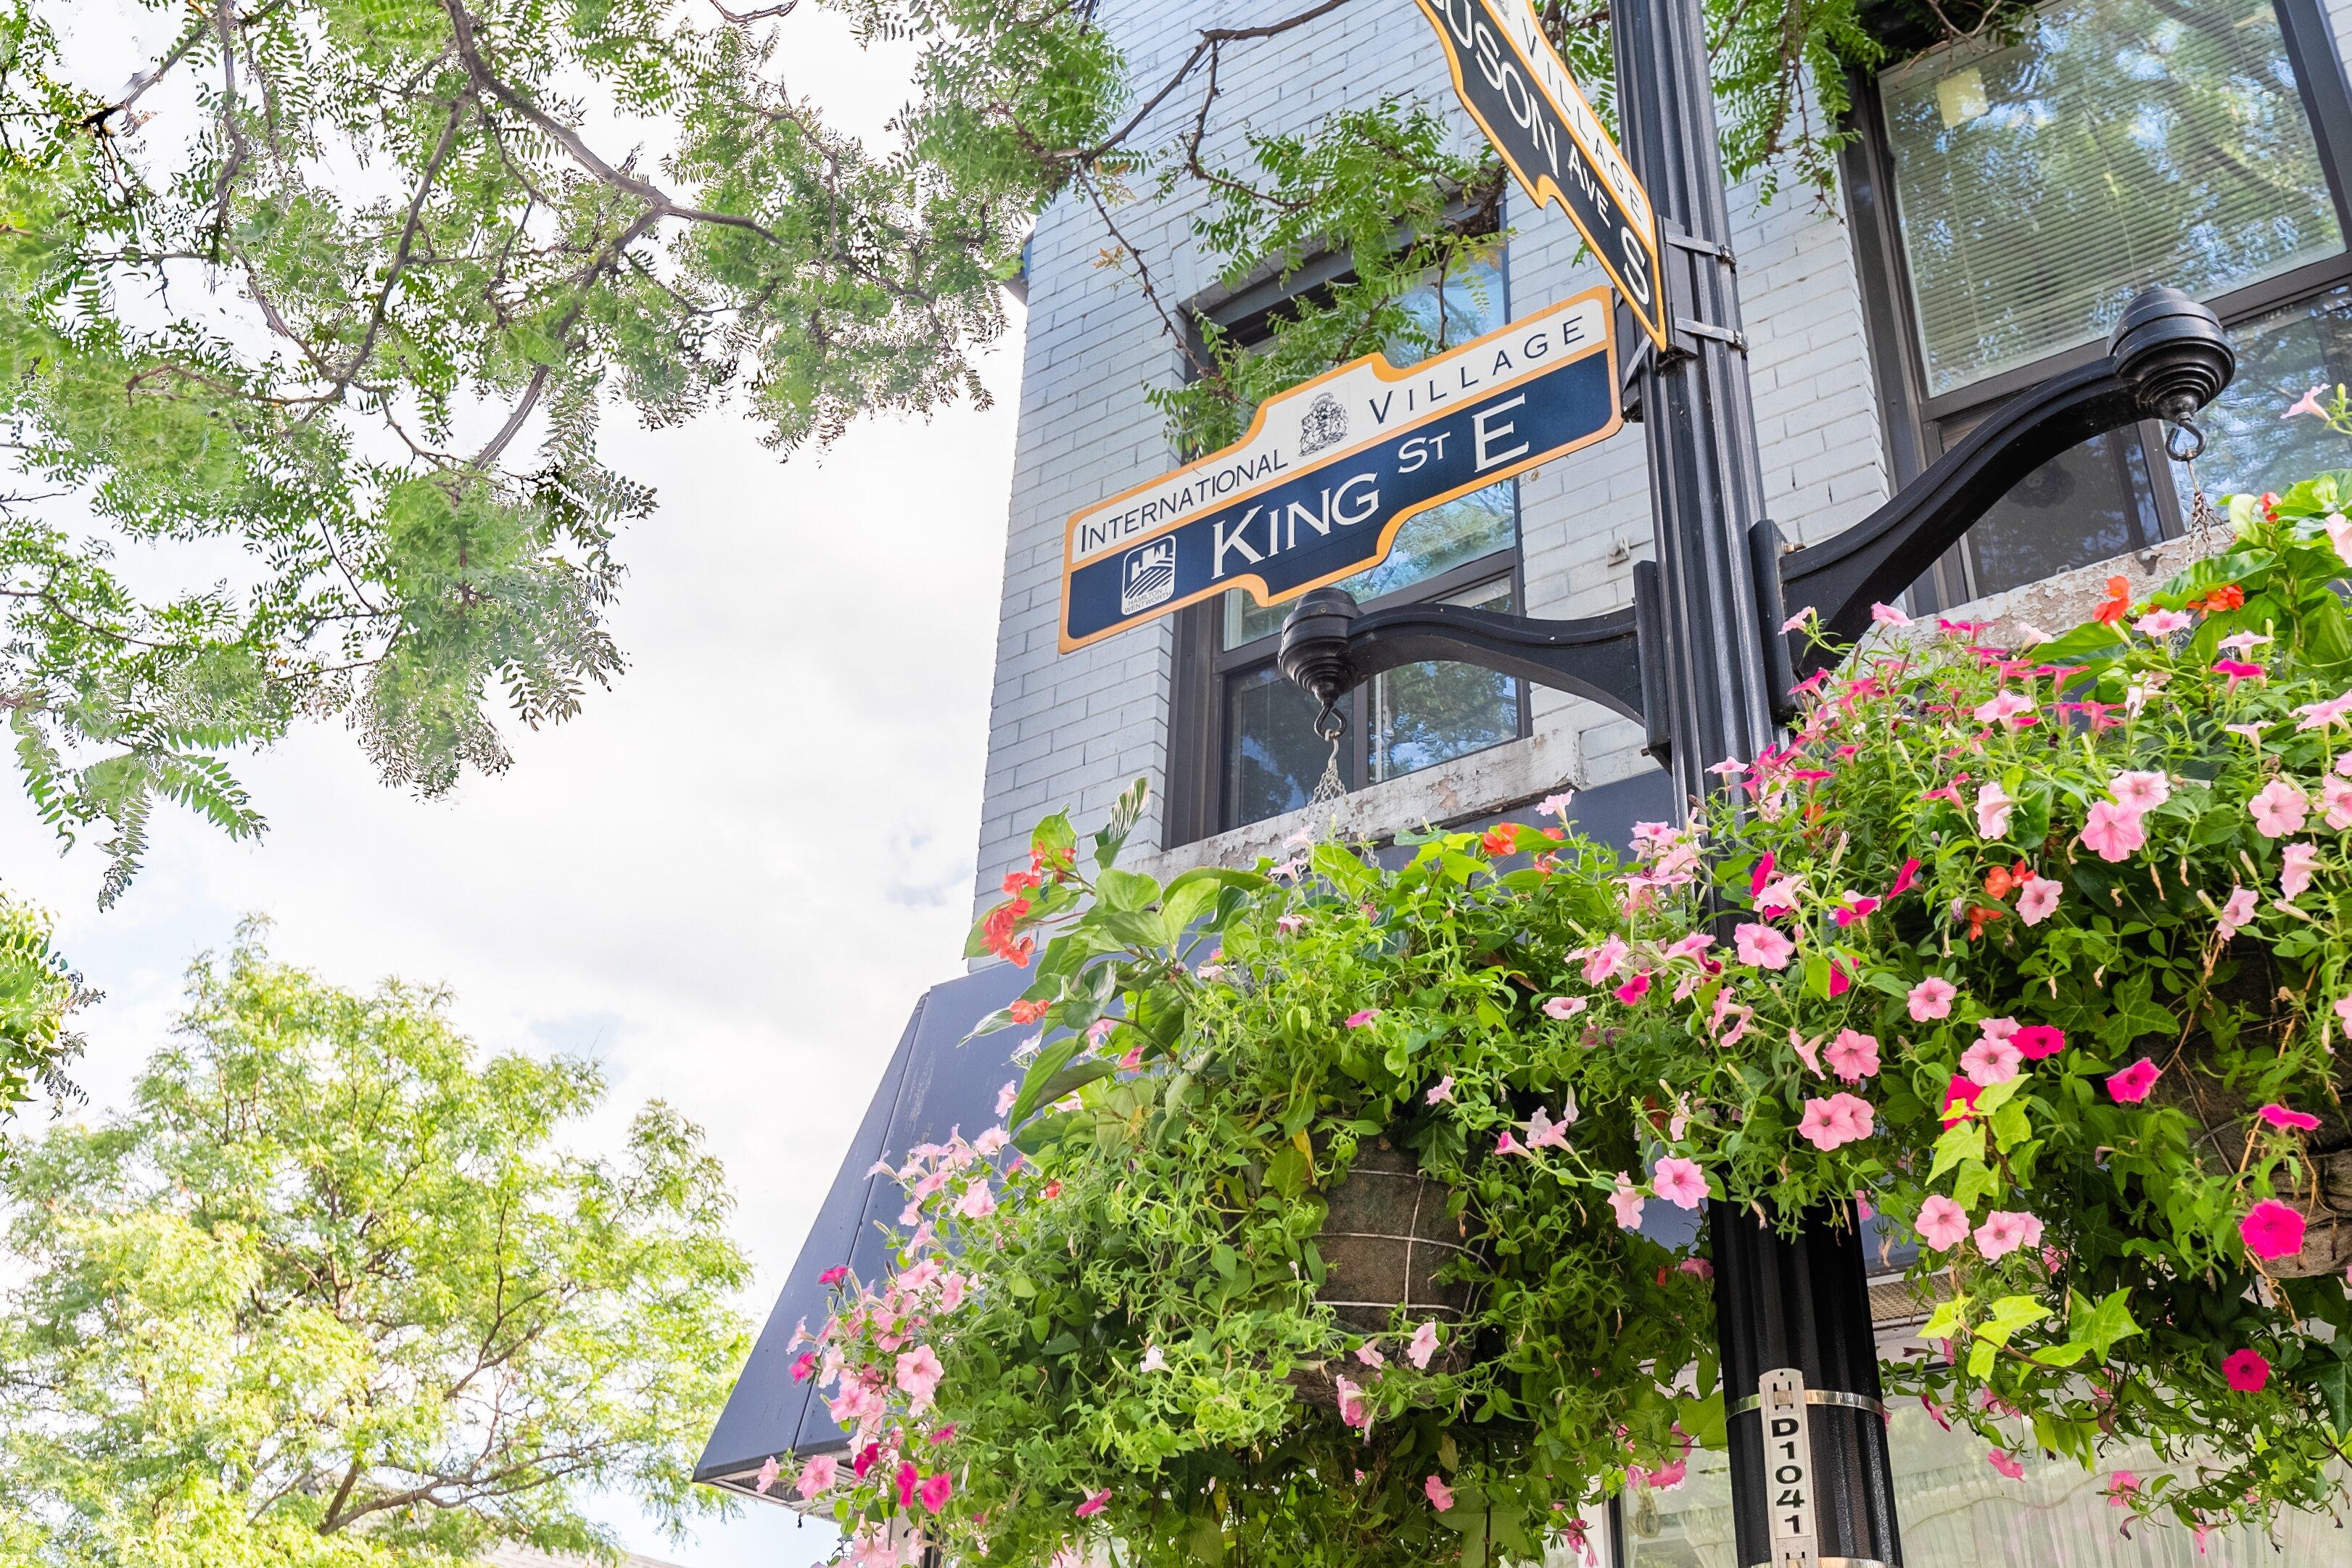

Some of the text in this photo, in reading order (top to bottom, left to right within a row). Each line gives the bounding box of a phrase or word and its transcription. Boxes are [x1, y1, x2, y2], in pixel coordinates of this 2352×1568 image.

[1430, 0, 1559, 178] USON
[1620, 226, 1650, 305] S
[1522, 17, 1642, 223] VILLAGE
[1081, 315, 1585, 553] INTERNATIONAL VILLAGE
[1210, 472, 1379, 579] KING
[1472, 392, 1530, 474] E
[1124, 591, 1172, 614] WENTWORTH
[1128, 588, 1163, 606] HAMILTON
[1771, 1418, 1805, 1535] D1041
